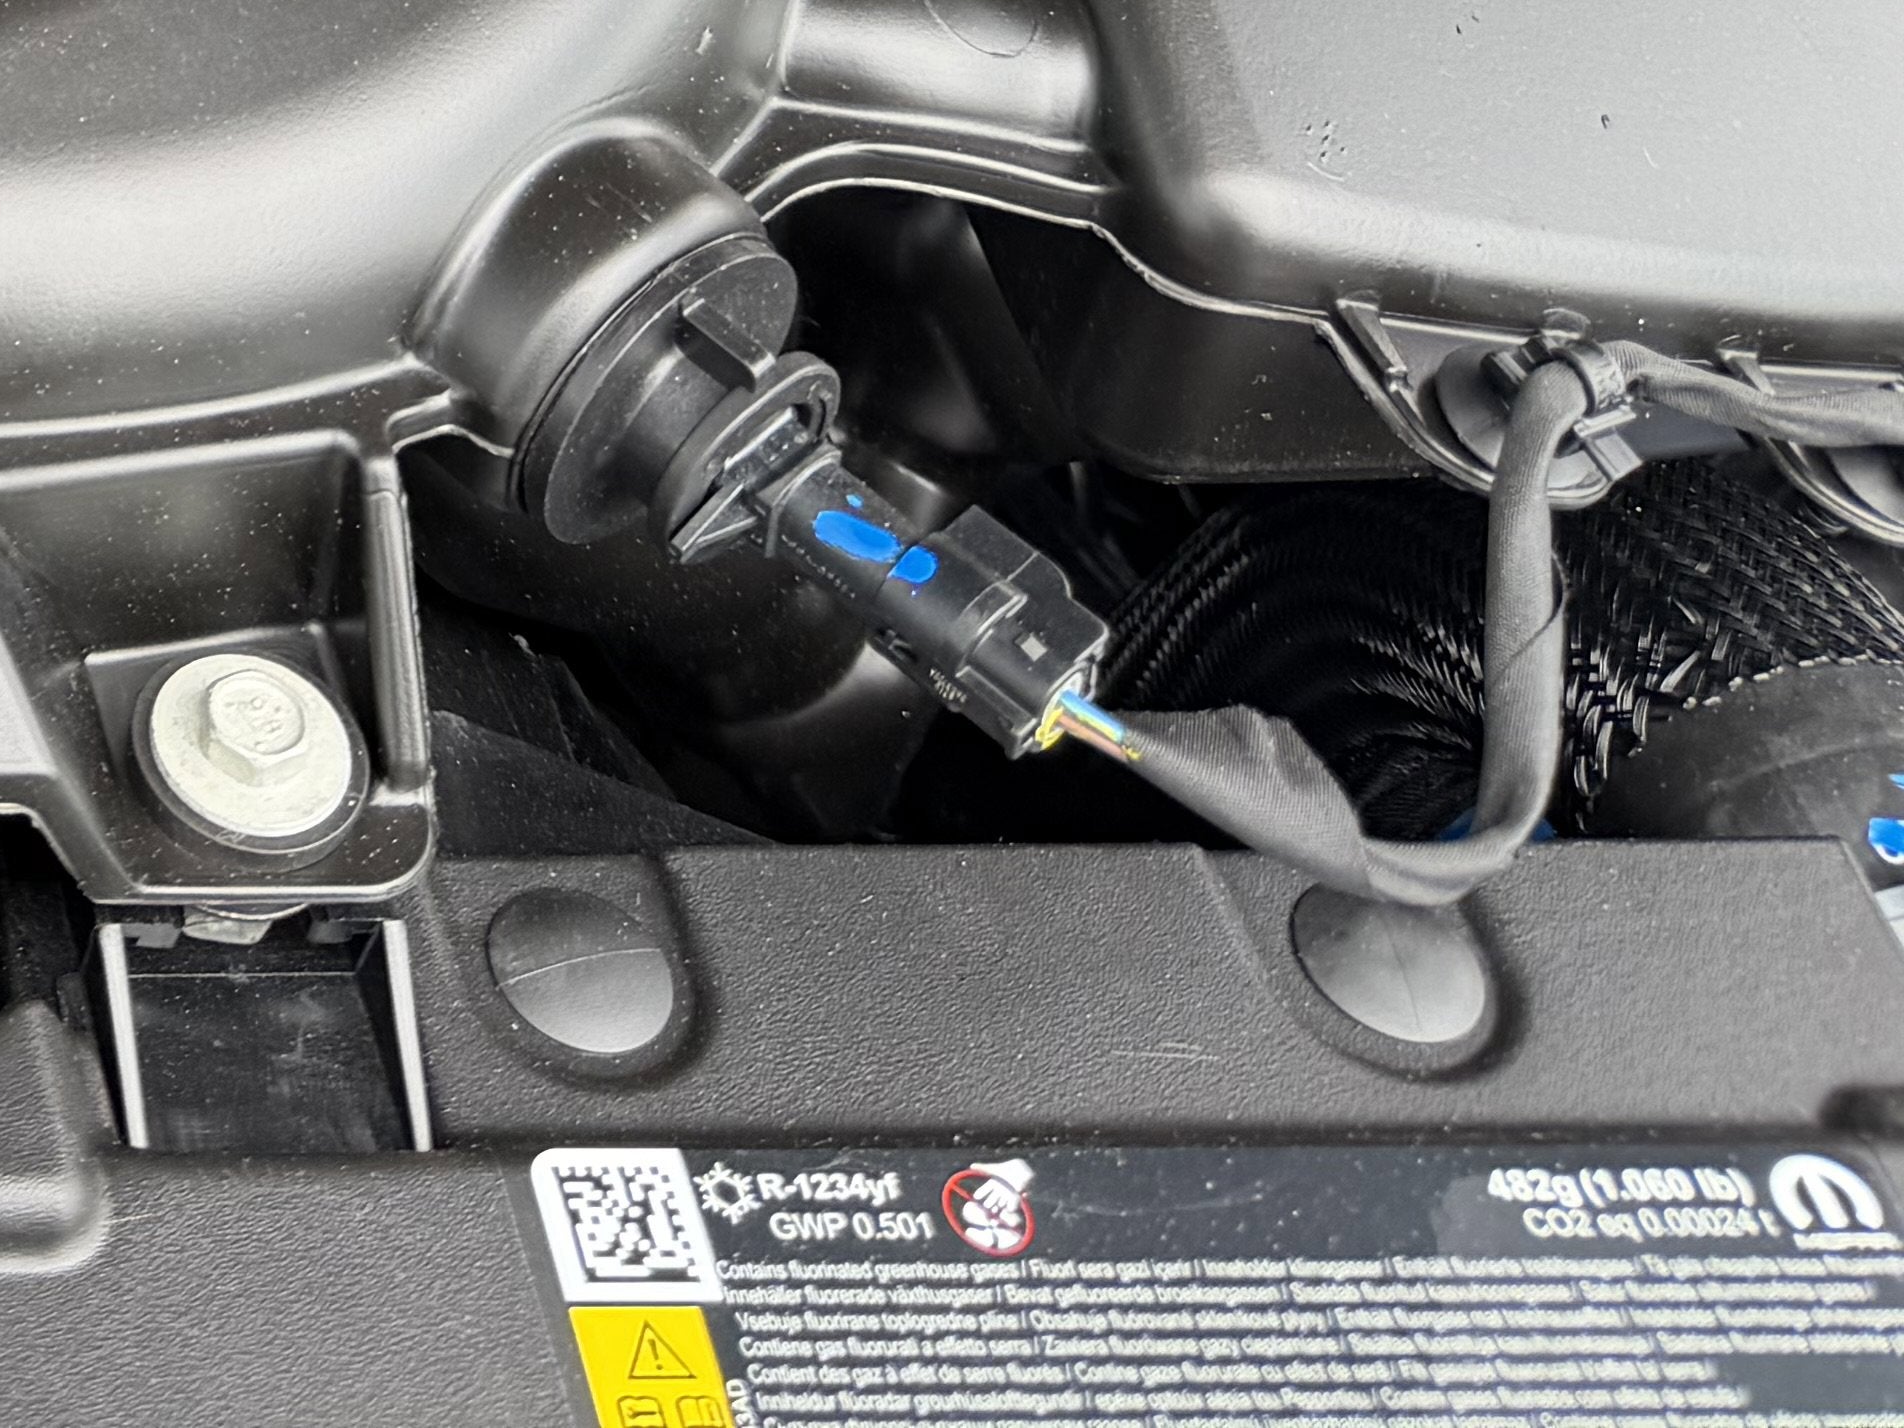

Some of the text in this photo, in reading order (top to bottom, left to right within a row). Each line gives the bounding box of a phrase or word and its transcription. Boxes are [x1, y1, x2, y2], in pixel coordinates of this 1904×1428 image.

[757, 1172, 901, 1206] R-1234yf
[1486, 1167, 1583, 1207] 482g
[769, 1211, 935, 1240] GWP 0.501
[1522, 1207, 1598, 1238] CO2
[716, 1259, 787, 1280] Contains
[788, 1260, 872, 1280] fluorinated
[874, 1261, 969, 1283] greenhouse
[971, 1262, 1019, 1283] gases
[724, 1377, 758, 1428] 3AD
